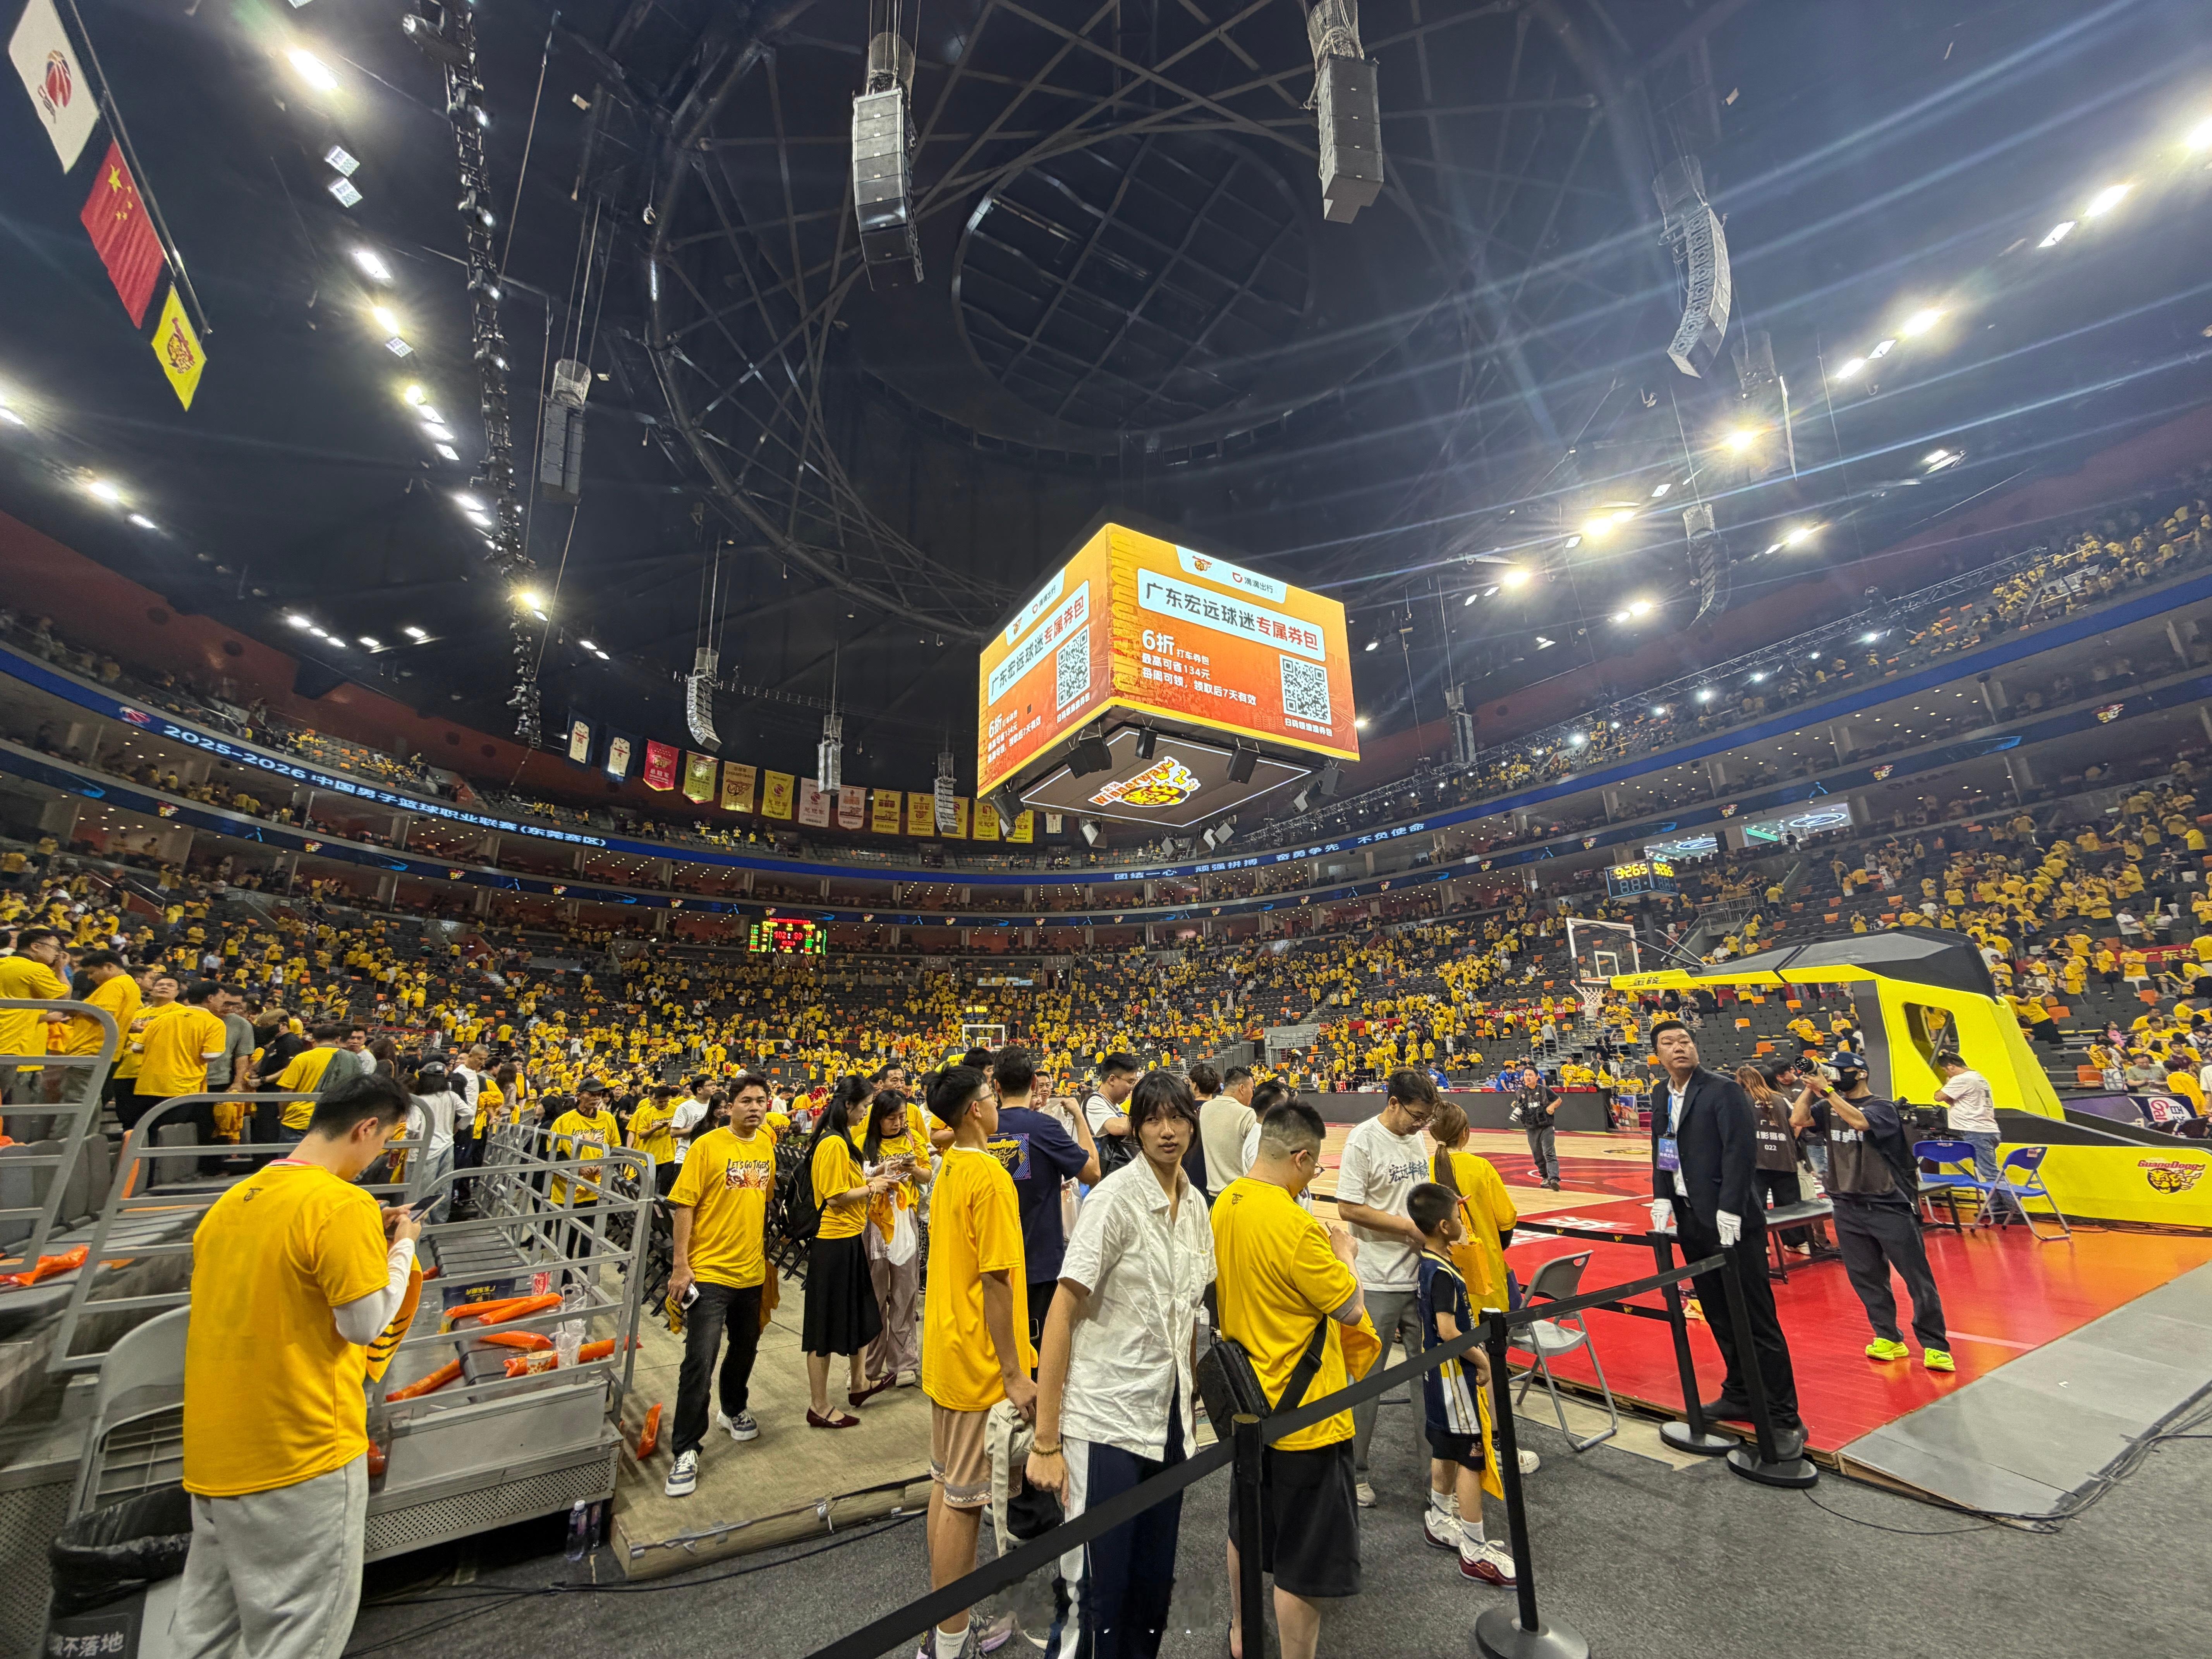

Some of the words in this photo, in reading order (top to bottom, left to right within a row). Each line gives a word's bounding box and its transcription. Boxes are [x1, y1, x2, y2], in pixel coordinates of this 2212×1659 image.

[1244, 576, 1273, 593] 滴滴出行
[1146, 582, 1318, 651] 广东宏远球迷专属券包
[991, 595, 1085, 696] 广东宏远球迷专属券包
[1142, 629, 1175, 656] 6折
[1176, 649, 1209, 666] 打车券包
[1142, 653, 1211, 680] 最高可省134元
[989, 713, 1003, 739] 6折
[1285, 718, 1333, 737] 扫码领滴滴券包
[164, 725, 306, 779] 2025-2026
[1114, 869, 1177, 881] 团结一心
[1195, 858, 1259, 873] 顽强拼搏
[1276, 843, 1340, 862] 奋勇争先
[1357, 822, 1425, 845] 不负使命
[774, 931, 787, 939] 102
[726, 1158, 744, 1172] LET'S
[745, 1160, 752, 1169] GO
[753, 1159, 769, 1171] TIGERS
[1388, 1158, 1429, 1183] 宏远华南
[2137, 1159, 2206, 1171] GuangDong
